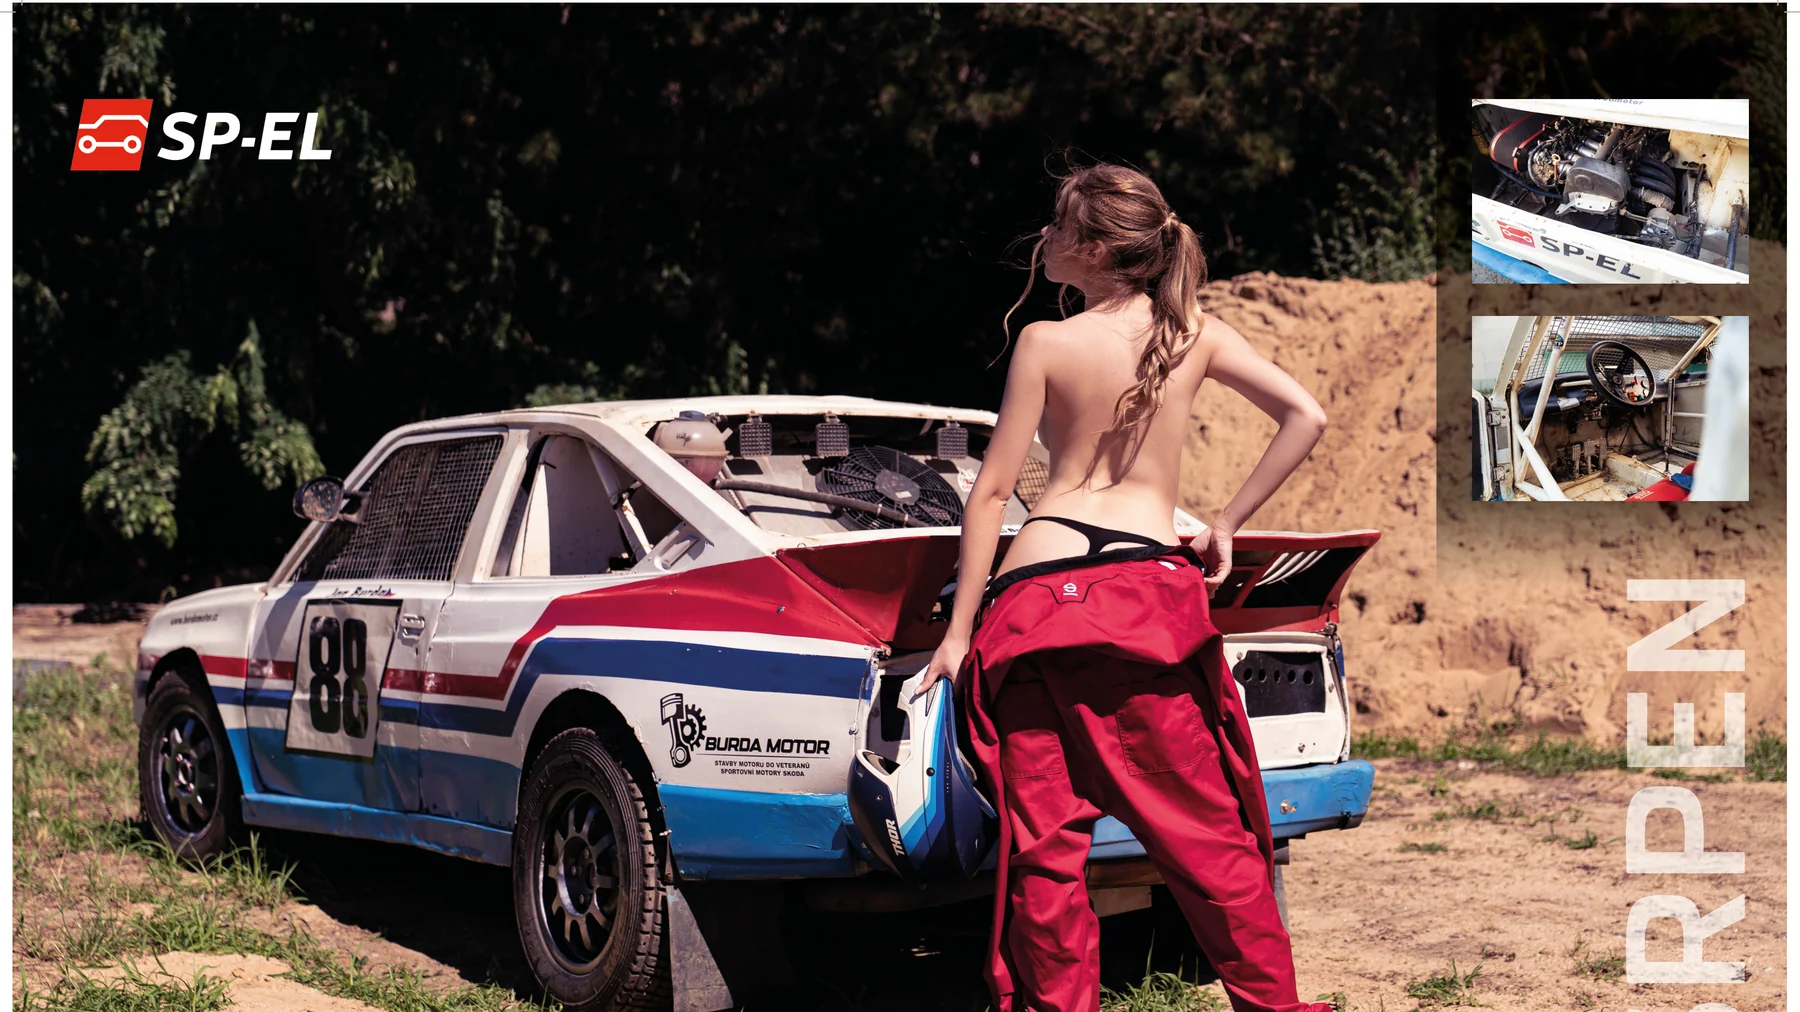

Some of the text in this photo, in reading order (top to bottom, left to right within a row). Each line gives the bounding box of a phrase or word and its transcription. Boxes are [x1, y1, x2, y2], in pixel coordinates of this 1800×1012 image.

[1540, 236, 1641, 279] SP-EL
[309, 616, 369, 738] 88
[705, 737, 830, 754] BURDA MOTOR
[885, 818, 905, 856] THOR
